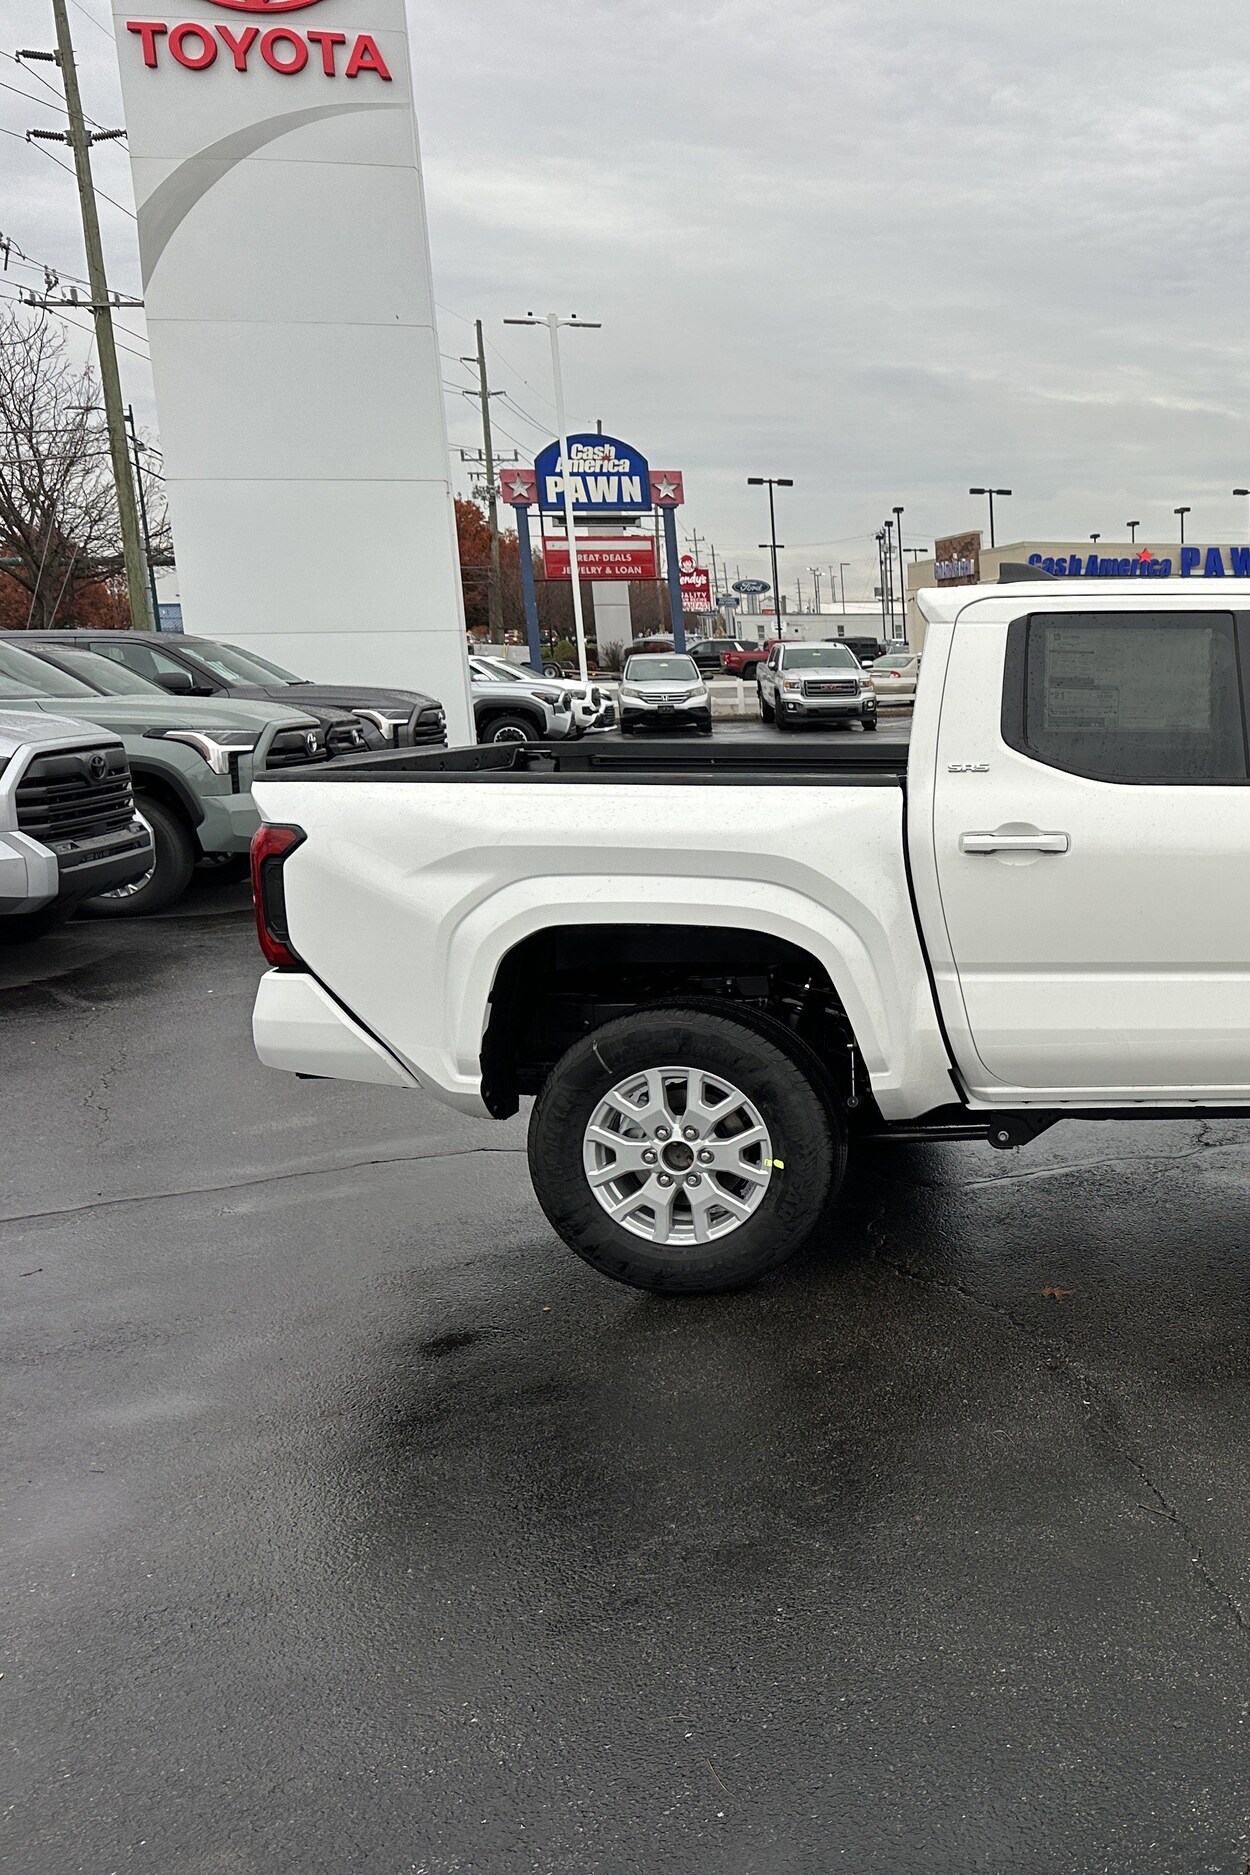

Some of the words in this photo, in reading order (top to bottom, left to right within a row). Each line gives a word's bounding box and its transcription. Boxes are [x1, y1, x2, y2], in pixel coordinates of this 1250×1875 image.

[126, 21, 392, 81] TOYOTA
[571, 443, 616, 460] Cash
[545, 476, 642, 503] PAWN
[577, 553, 600, 562] REAT
[602, 553, 632, 562] DEALS
[1028, 553, 1083, 576] Cash
[1084, 554, 1172, 577] America
[562, 566, 602, 575] JEELRY
[605, 566, 613, 575] &
[615, 566, 642, 574] LOAN
[680, 571, 708, 588] endy's
[740, 581, 764, 592] Ford
[681, 591, 707, 599] ALITY
